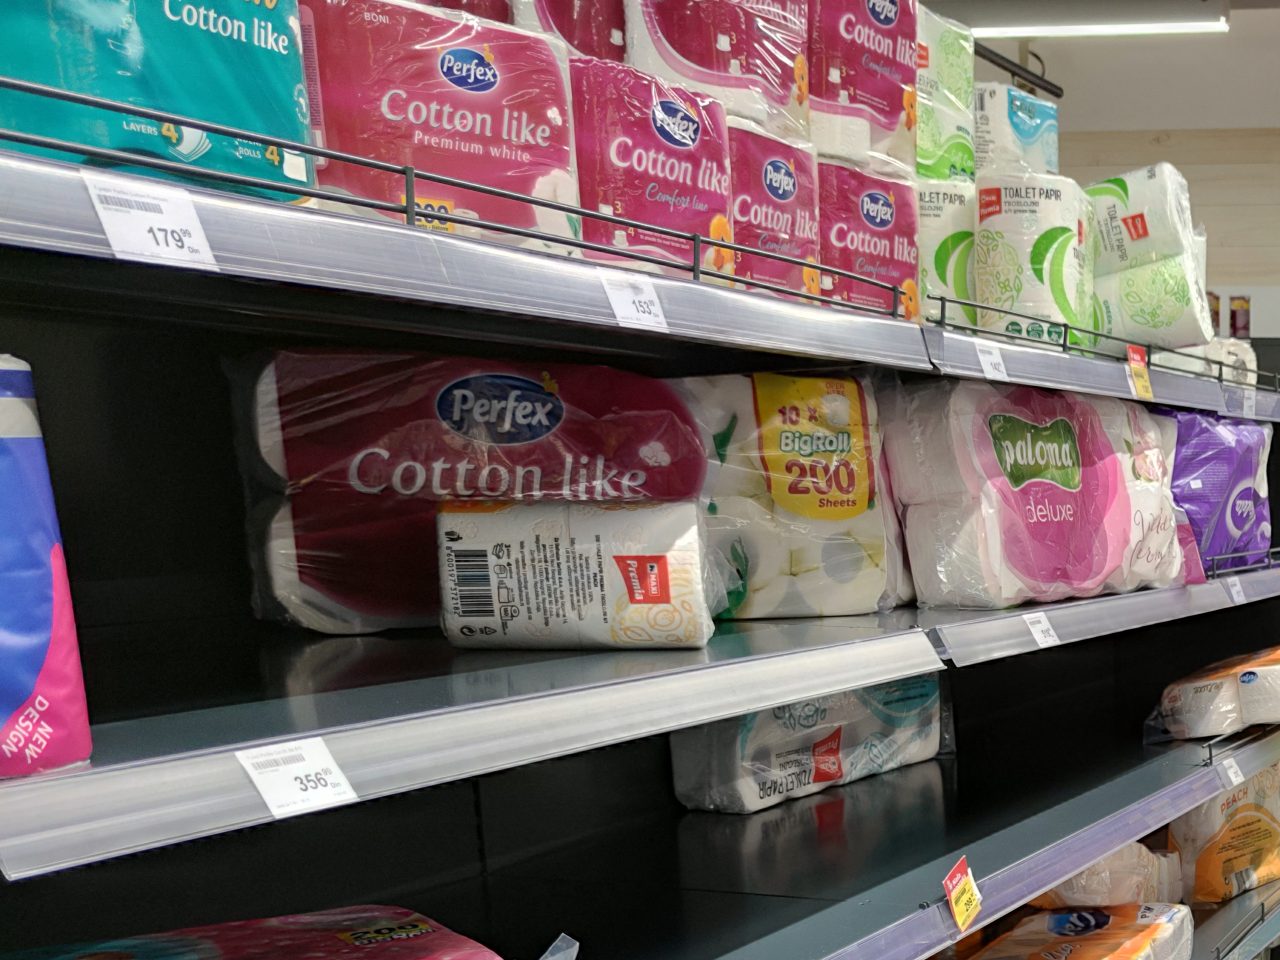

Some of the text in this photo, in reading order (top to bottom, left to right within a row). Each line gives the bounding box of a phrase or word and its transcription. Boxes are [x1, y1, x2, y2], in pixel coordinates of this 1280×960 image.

[164, 0, 290, 55] Cotton like
[839, 14, 917, 69] Cotton like
[442, 55, 498, 83] Perfex
[123, 121, 179, 143] LAYERS 4
[381, 90, 551, 148] Cotton like
[265, 146, 280, 166] 4
[414, 131, 531, 163] Premium white
[609, 136, 730, 196] Cotton like
[766, 165, 795, 195] Perfex
[645, 183, 690, 213] Comfort
[942, 193, 966, 206] PAPIR
[1003, 186, 1062, 201] TOALET PAPIR
[733, 195, 818, 240] Cotton like
[862, 196, 894, 223] Perfex
[147, 225, 185, 249] 179
[830, 222, 917, 265] Cotton like
[1106, 204, 1129, 263] TOALET PAPIR
[632, 299, 652, 315] 153
[453, 389, 552, 434] Perfex
[778, 405, 801, 426] 10
[779, 430, 851, 457] BigRoll
[1001, 432, 1074, 472] paloma
[348, 446, 648, 500] Cotton like
[785, 458, 856, 496] 200
[818, 498, 857, 508] Sheets
[1026, 497, 1074, 523] deluxe
[625, 560, 645, 601] Premia
[651, 573, 659, 595] MAXI
[1, 694, 50, 758] DESIGN
[25, 720, 54, 765] NEW
[293, 771, 328, 792] 356
[758, 781, 784, 800] PAPIR
[1220, 787, 1249, 815] PEACH
